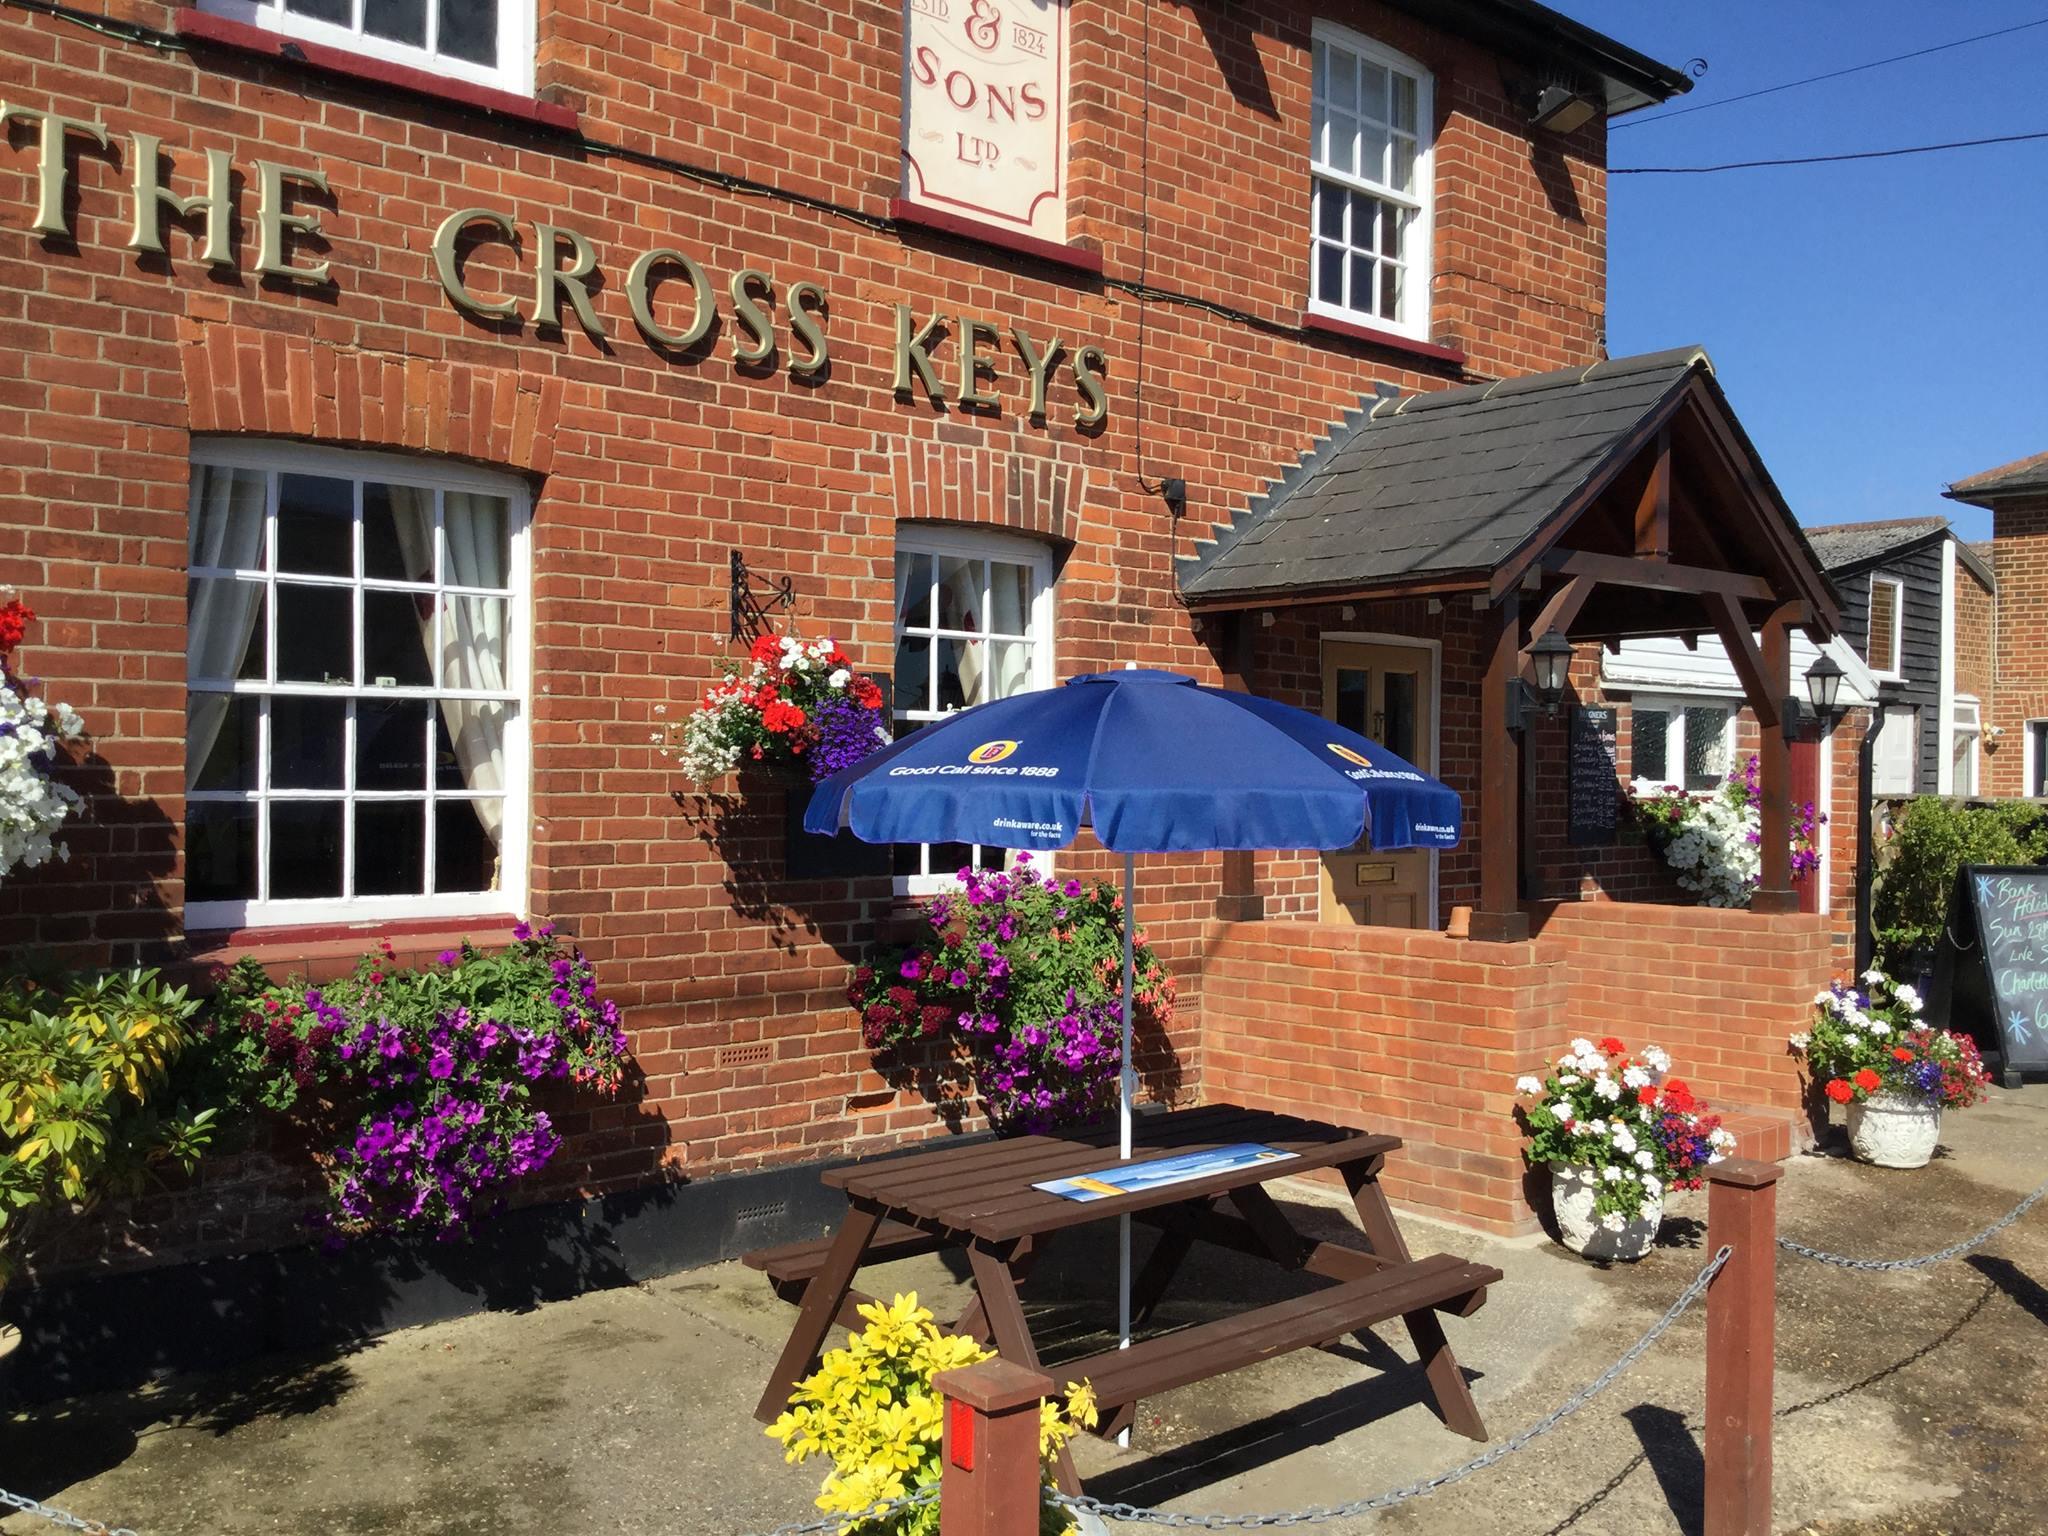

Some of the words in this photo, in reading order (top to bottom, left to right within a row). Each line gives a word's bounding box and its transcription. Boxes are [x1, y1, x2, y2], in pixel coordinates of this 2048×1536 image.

[1013, 27, 1046, 54] 1824
[911, 45, 1046, 121] SONS
[0, 105, 331, 285] THE
[431, 207, 829, 373] CROSS
[891, 302, 1108, 425] KEYS
[889, 765, 940, 776] Good
[938, 764, 973, 776] Call
[971, 765, 1018, 776] since
[1019, 766, 1060, 777] 1888
[993, 818, 1062, 831] drinkaware.co.uk
[1997, 877, 2040, 909] Bank
[1989, 917, 2023, 946] Sun
